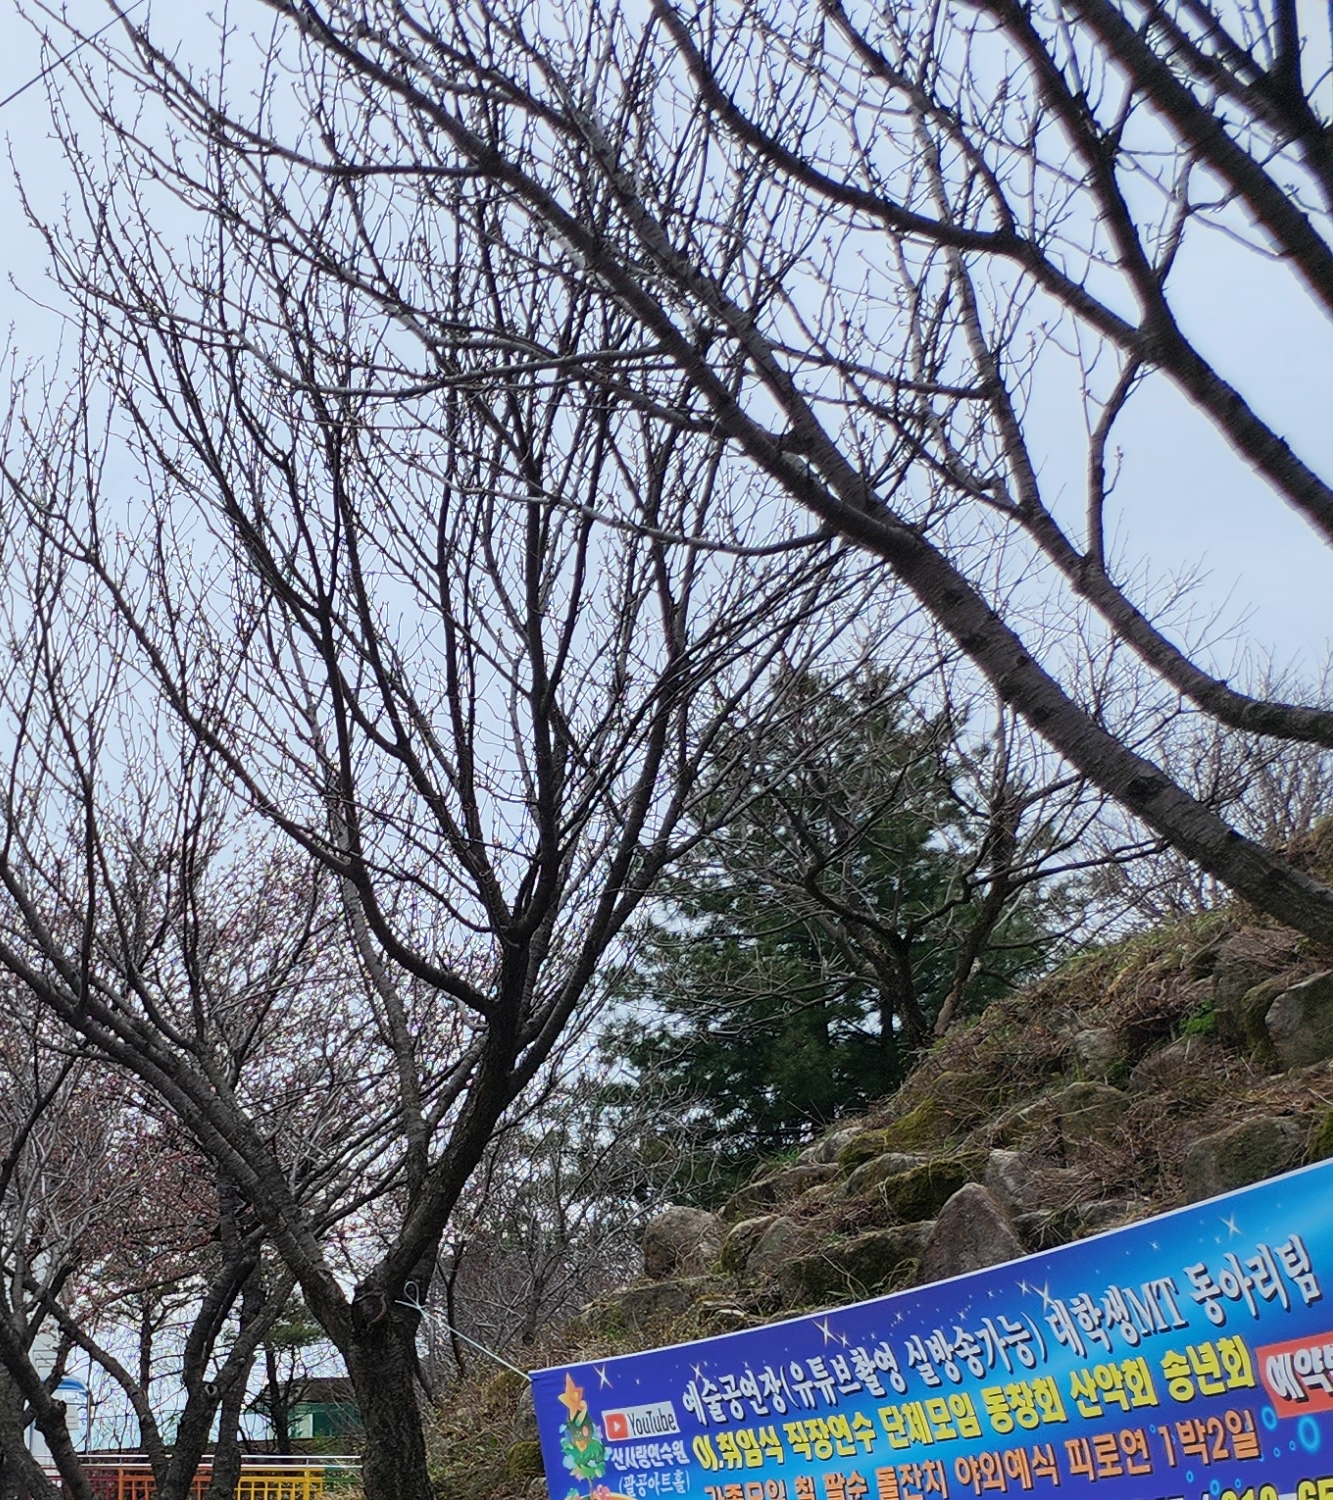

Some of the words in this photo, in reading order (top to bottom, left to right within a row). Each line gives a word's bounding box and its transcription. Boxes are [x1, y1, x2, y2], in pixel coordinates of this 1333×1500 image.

[682, 1341, 907, 1426] 예술공연장(유튜브촬영
[904, 1311, 1047, 1387] 실방송가능)
[1045, 1276, 1188, 1356] 대학생MT
[1184, 1233, 1322, 1325] 동아리팀
[784, 1410, 877, 1461] 직장연수
[878, 1391, 982, 1449] 단체모임
[980, 1374, 1068, 1433] 동창회
[1070, 1356, 1158, 1418] 산악회
[1159, 1334, 1256, 1402] 송년회
[630, 1409, 677, 1436] YouTube
[611, 1440, 691, 1471] 산사랑연수원
[954, 1443, 1060, 1495] 야외예식
[1064, 1428, 1152, 1482] 피로연
[618, 1469, 691, 1498] (팔공아트홀)
